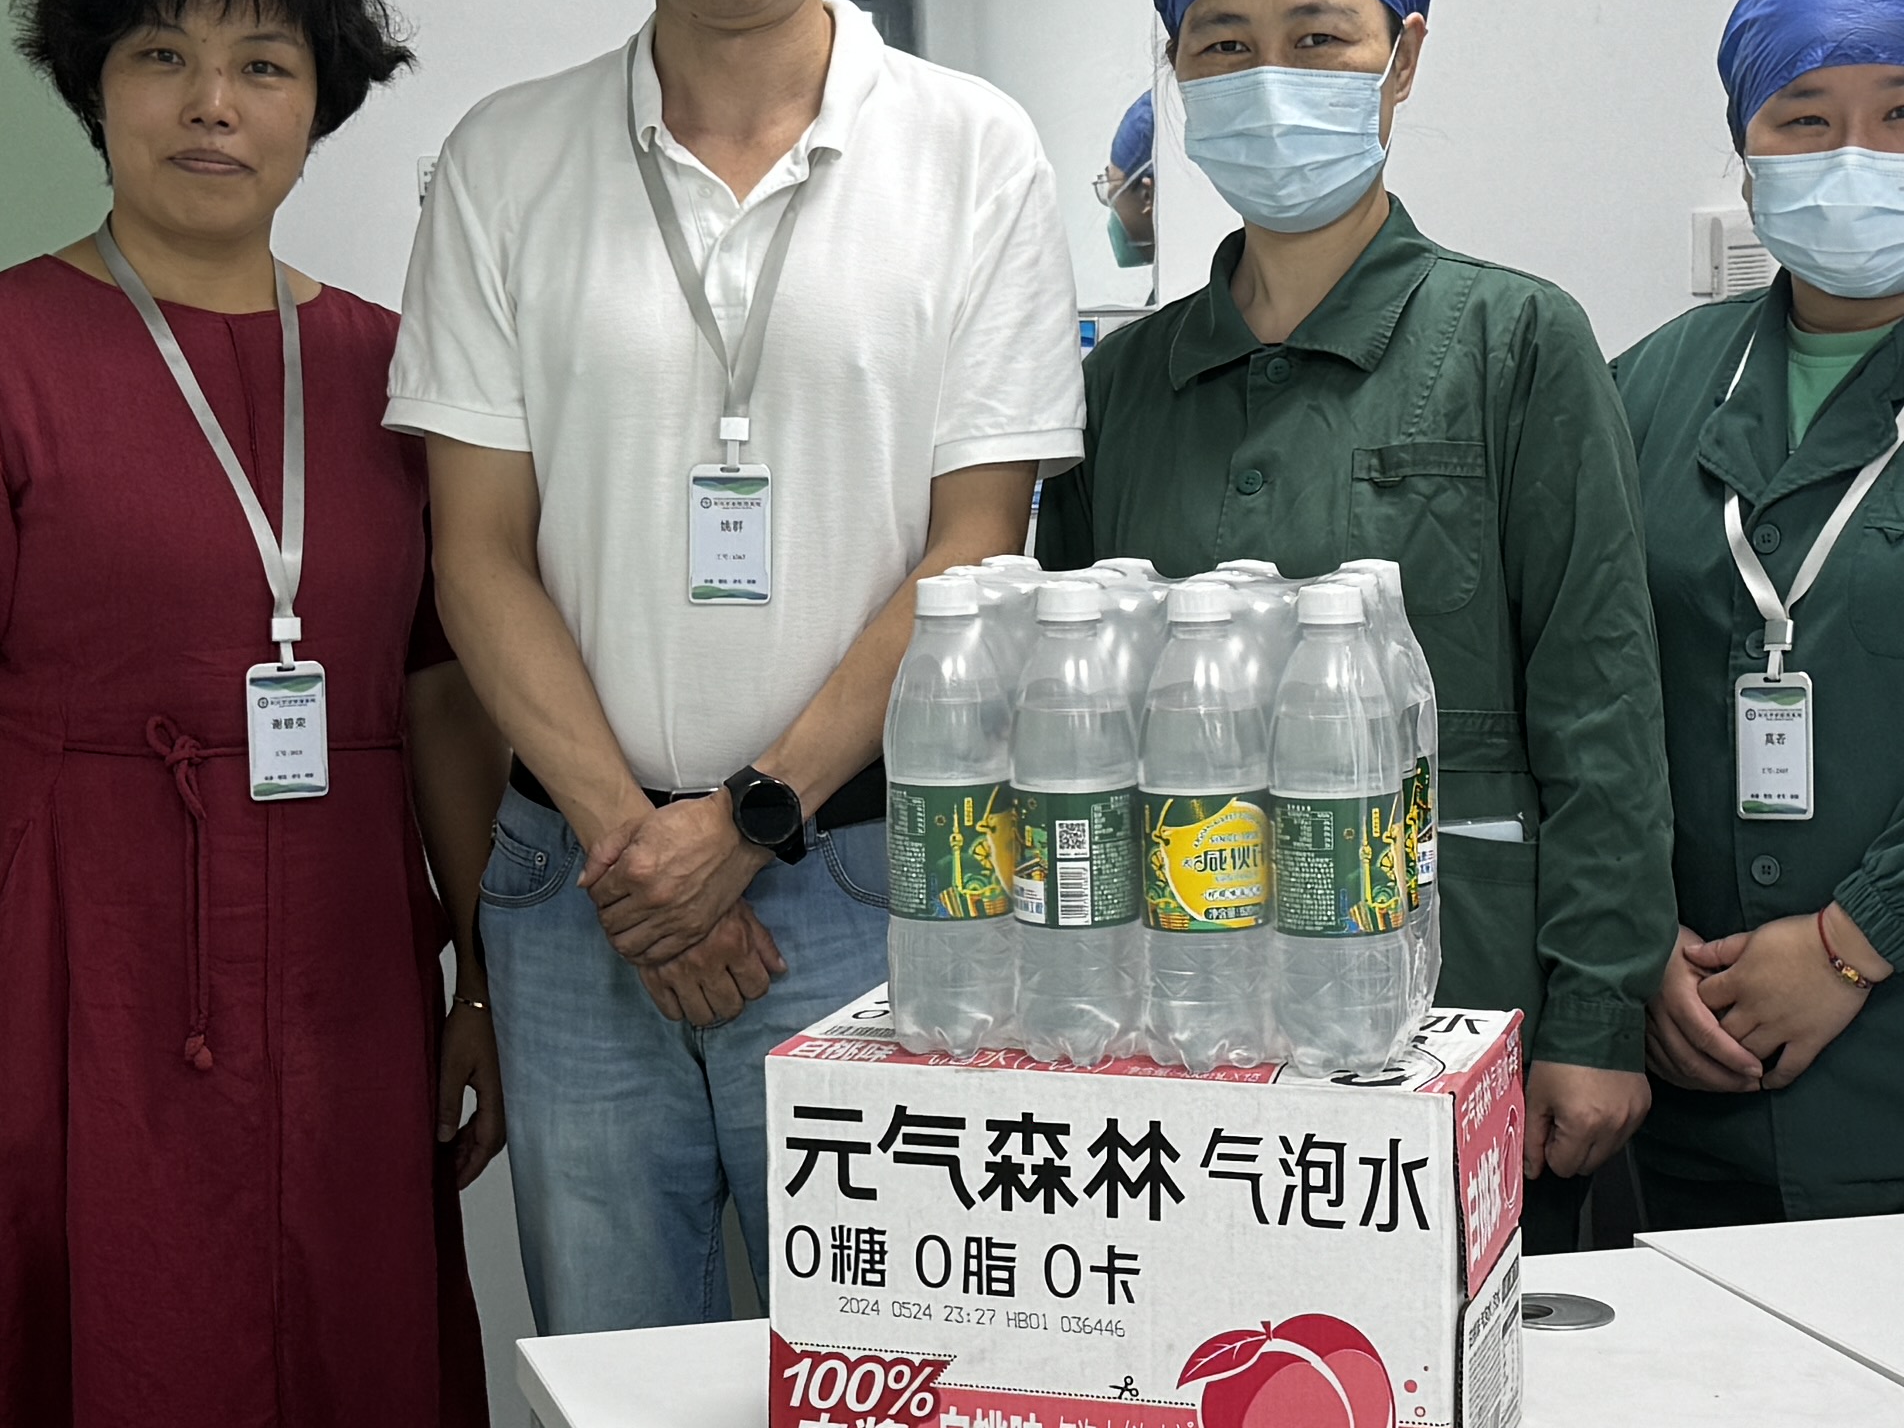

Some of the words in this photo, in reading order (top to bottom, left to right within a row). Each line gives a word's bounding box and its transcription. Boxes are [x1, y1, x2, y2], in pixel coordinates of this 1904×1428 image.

[785, 1105, 1184, 1221] 元气森林
[1200, 1128, 1430, 1233] 气泡水
[786, 1225, 888, 1287] 0糖
[916, 1235, 1017, 1297] 0脂
[1045, 1244, 1141, 1304] 0卡
[839, 1297, 880, 1316] 2024
[892, 1301, 932, 1321] 0524
[944, 1305, 996, 1325] 23:27
[1061, 1316, 1126, 1338] 036446
[783, 1356, 934, 1418] 100%
